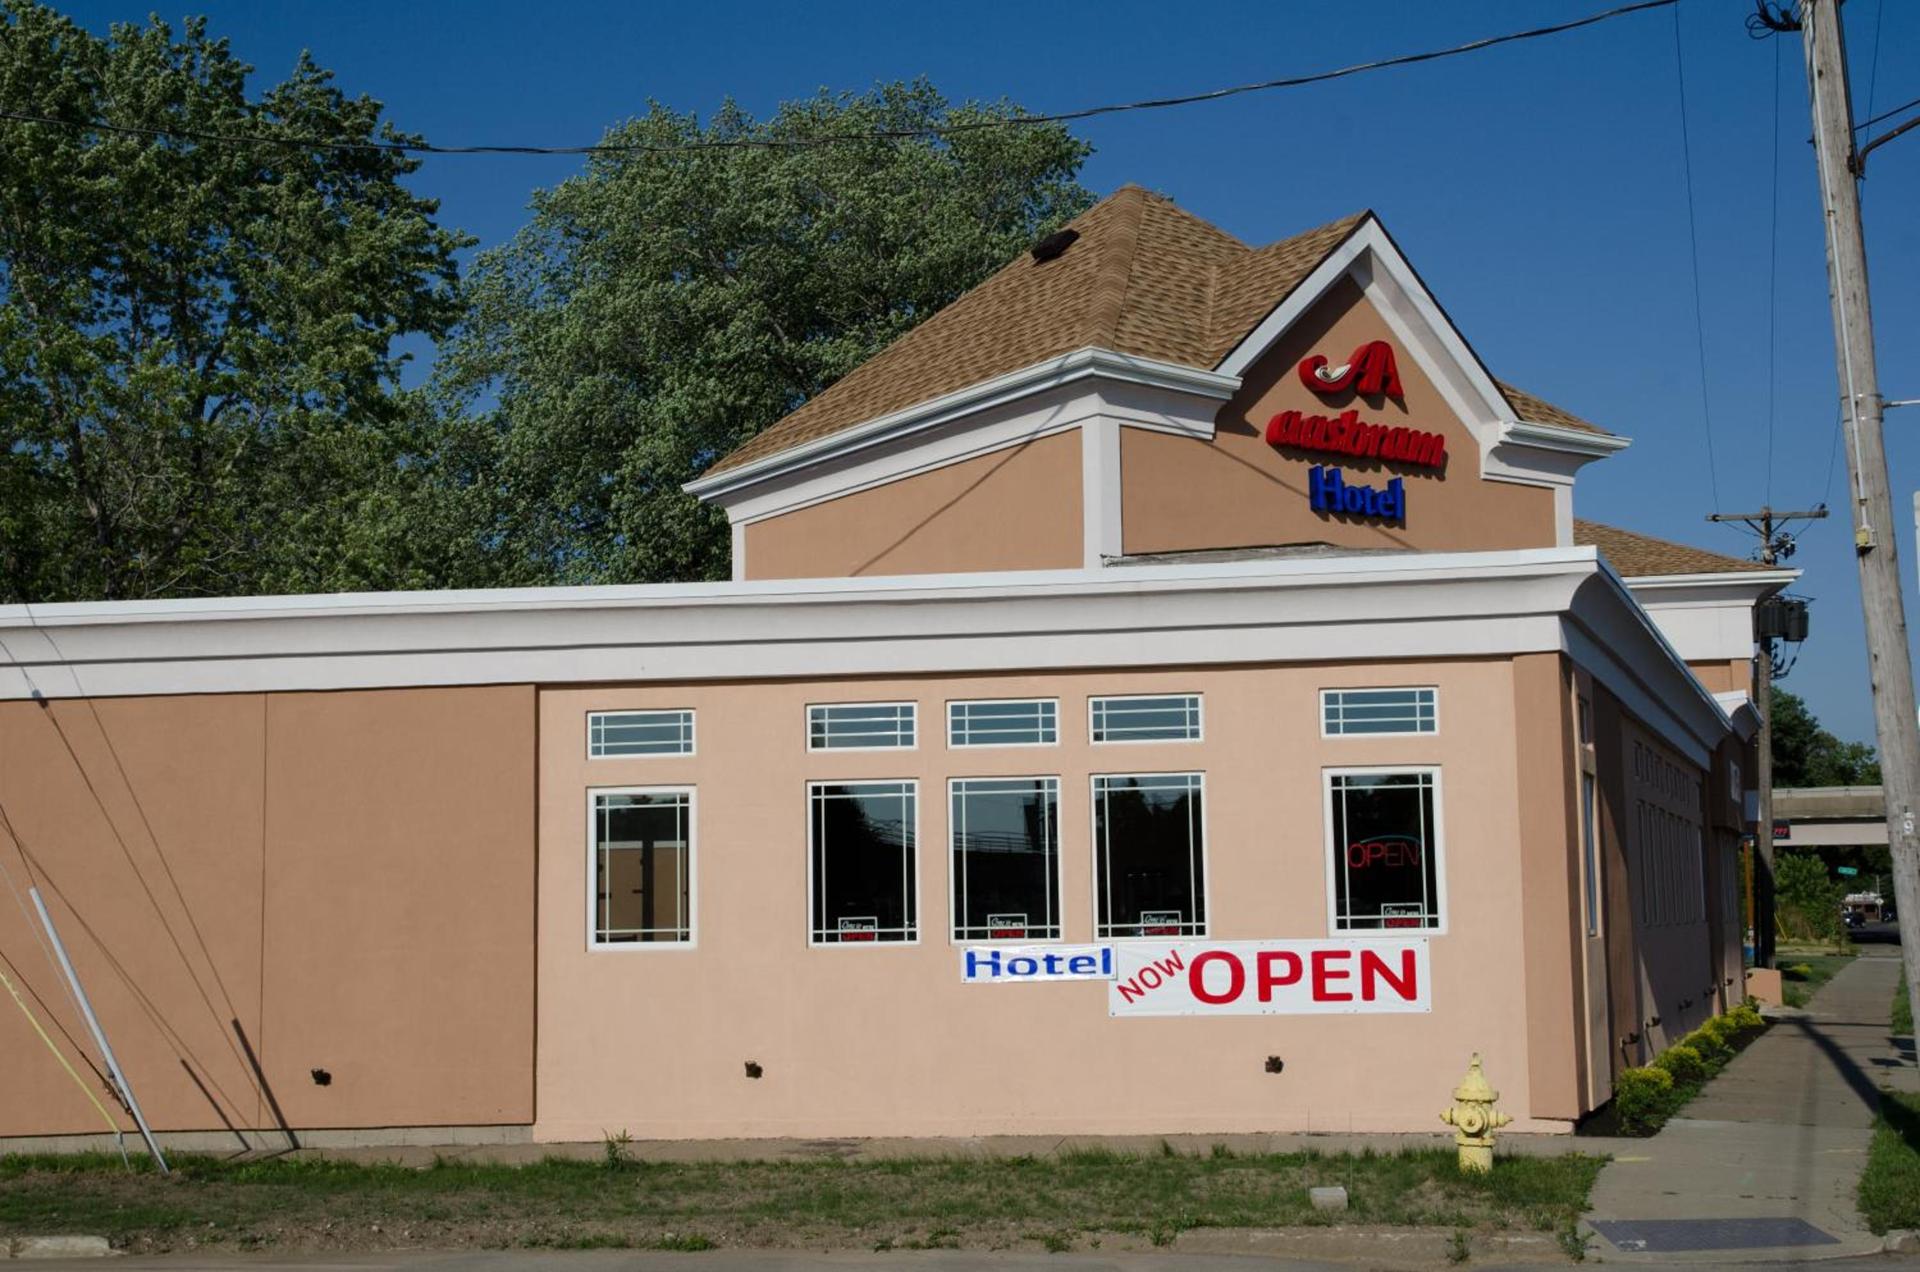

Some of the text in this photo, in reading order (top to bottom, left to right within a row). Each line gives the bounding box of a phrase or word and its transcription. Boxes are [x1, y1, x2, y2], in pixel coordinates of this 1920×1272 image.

[1308, 464, 1406, 520] Hotel
[1347, 842, 1420, 868] OPEN
[966, 948, 1111, 978] Hotel
[1117, 949, 1417, 1004] NOW OPEN
